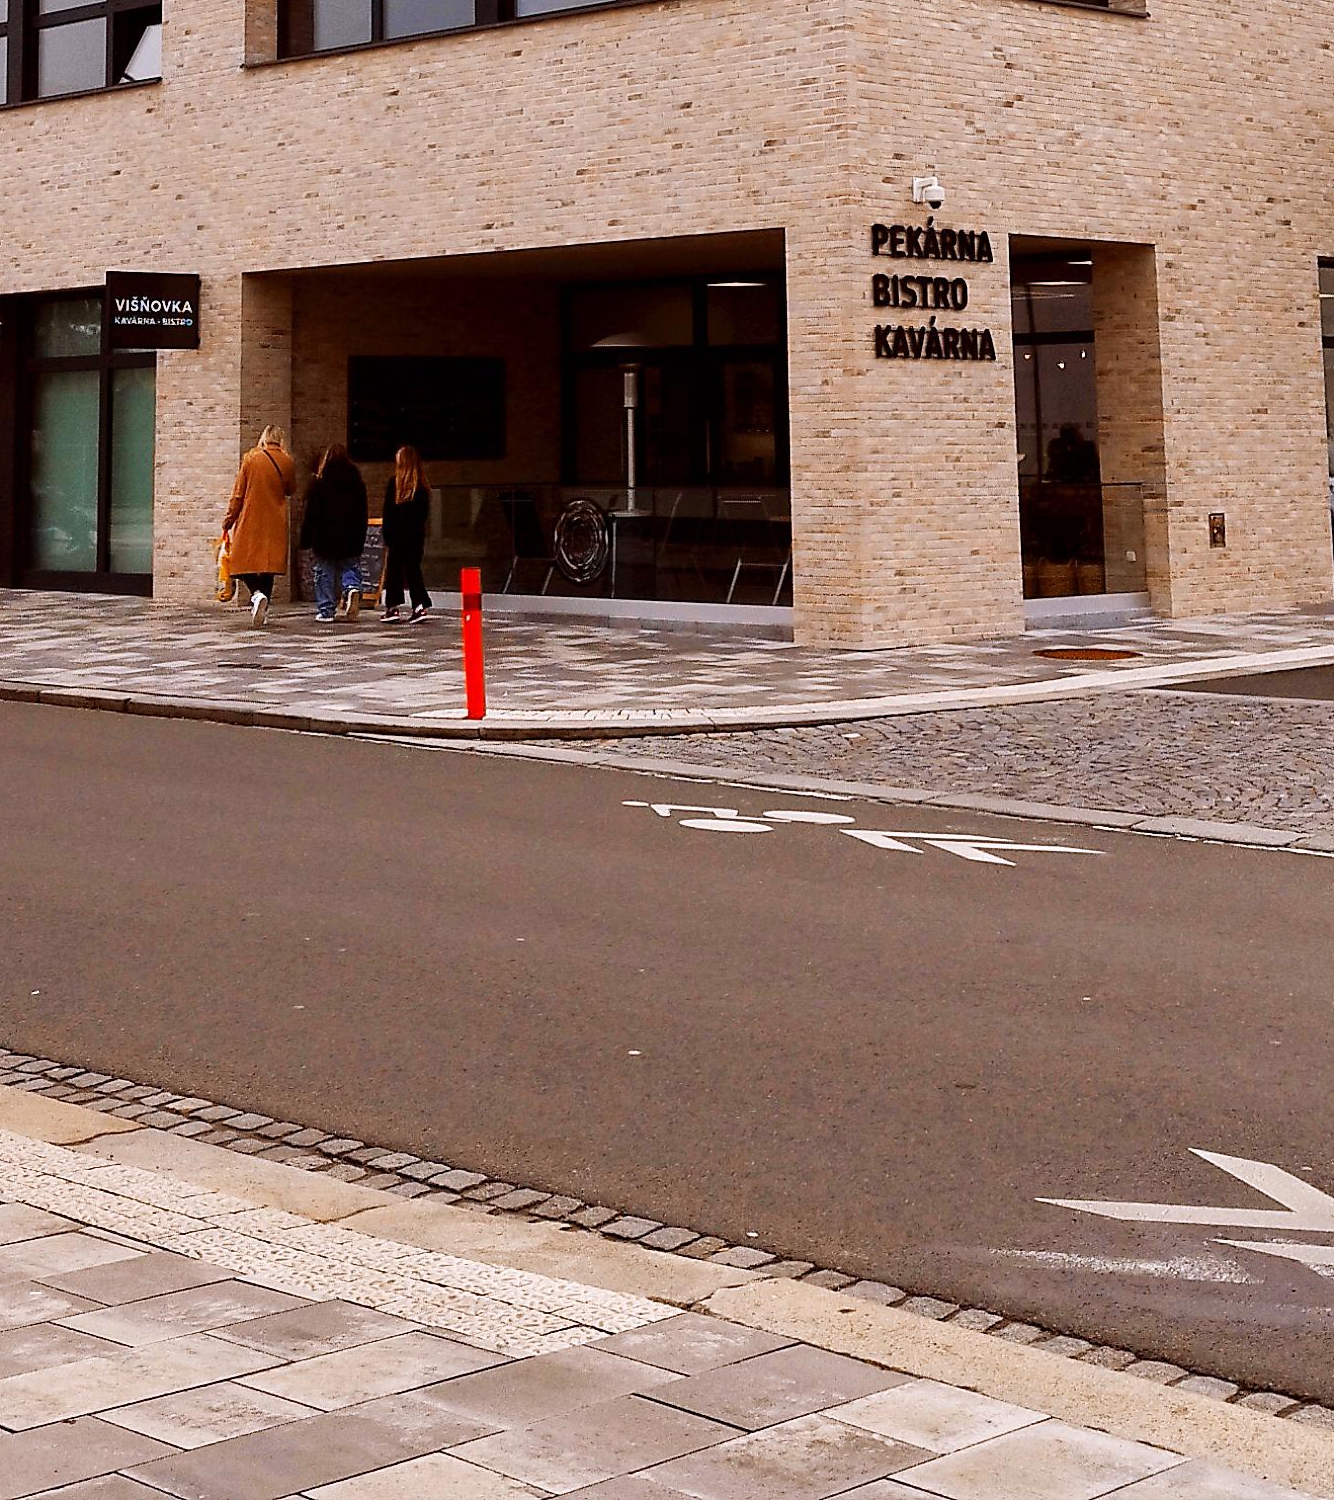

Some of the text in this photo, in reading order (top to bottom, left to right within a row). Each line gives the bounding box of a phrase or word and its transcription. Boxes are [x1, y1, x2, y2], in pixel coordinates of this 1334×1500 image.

[871, 216, 994, 262] PEKÁRNA
[115, 296, 193, 313] VIŠŇOVKA
[872, 273, 968, 311] BISTRO
[114, 316, 194, 326] KAVÁRNA BISTRO
[874, 315, 997, 361] KAVÁRNA
